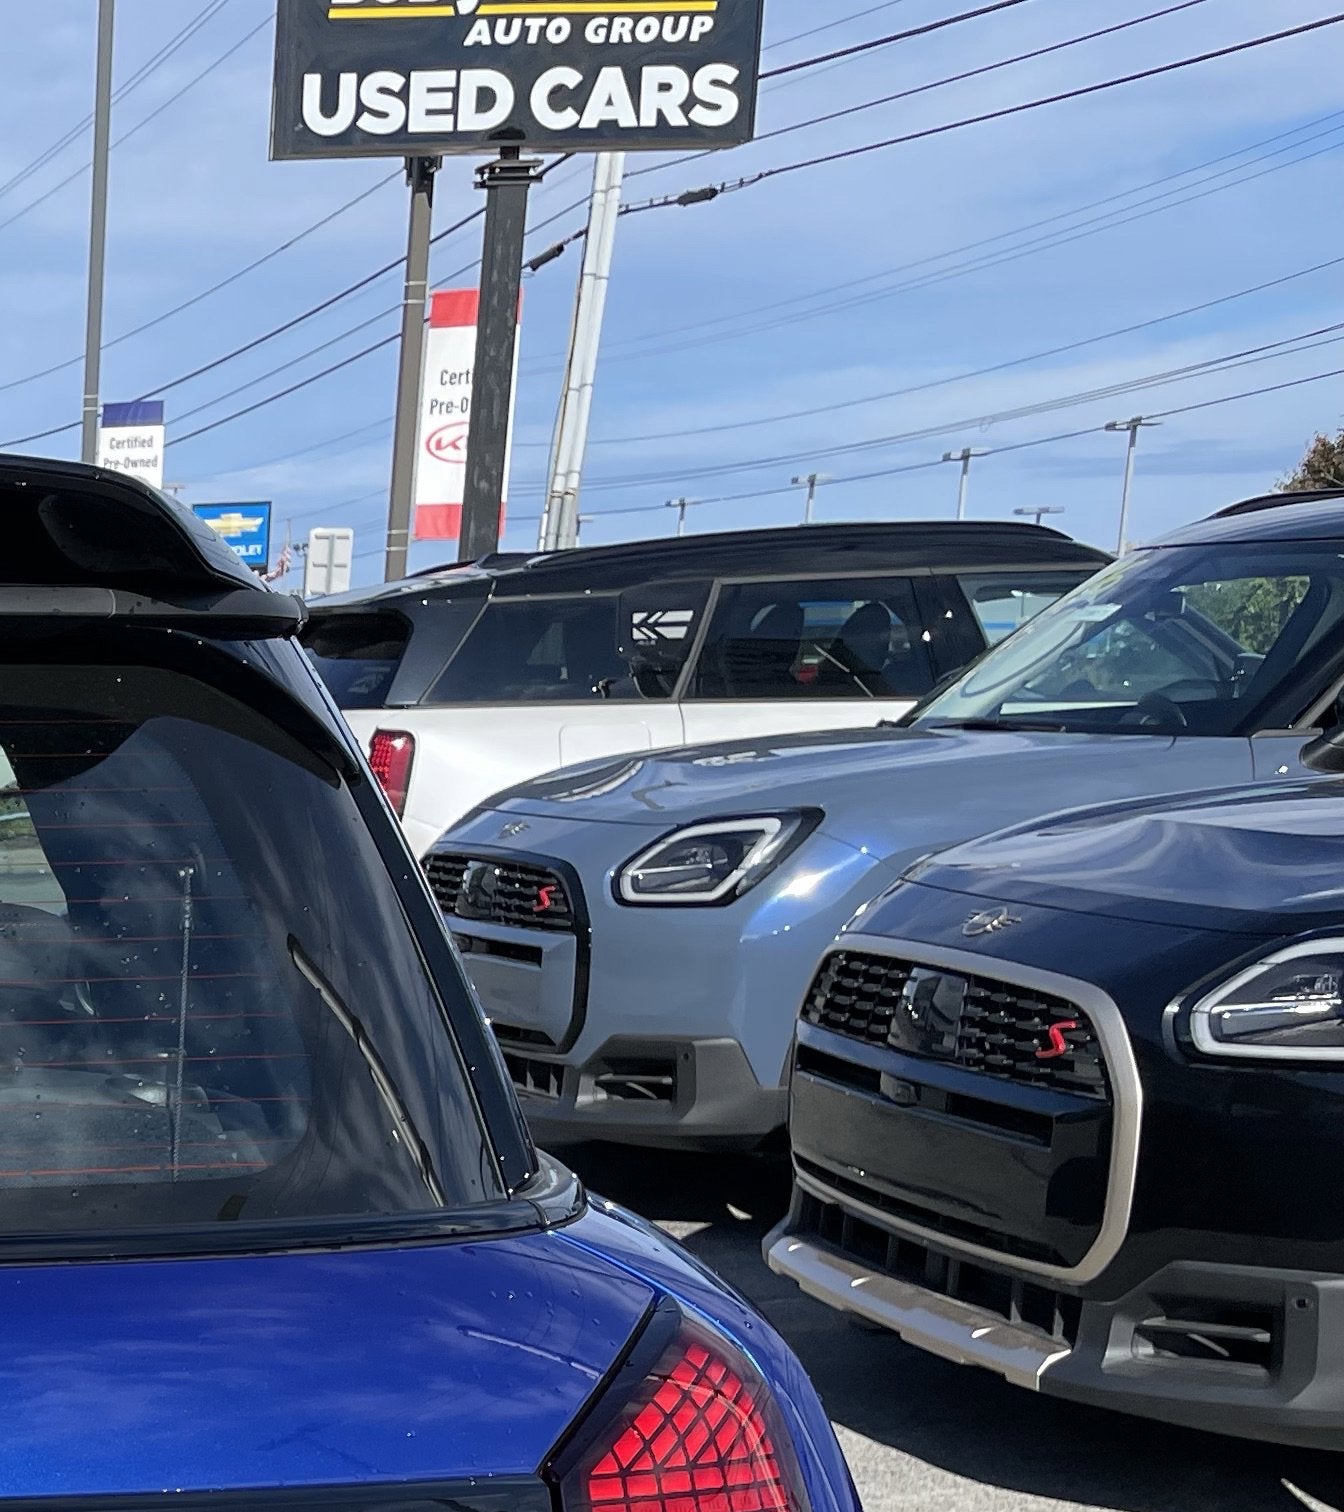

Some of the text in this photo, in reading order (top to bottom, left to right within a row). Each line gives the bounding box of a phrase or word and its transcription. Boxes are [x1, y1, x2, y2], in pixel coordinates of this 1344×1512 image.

[463, 15, 714, 46] AUTO GROUP
[300, 63, 741, 137] USED CARS
[109, 435, 154, 450] Certified
[103, 455, 158, 470] Pre-Owned
